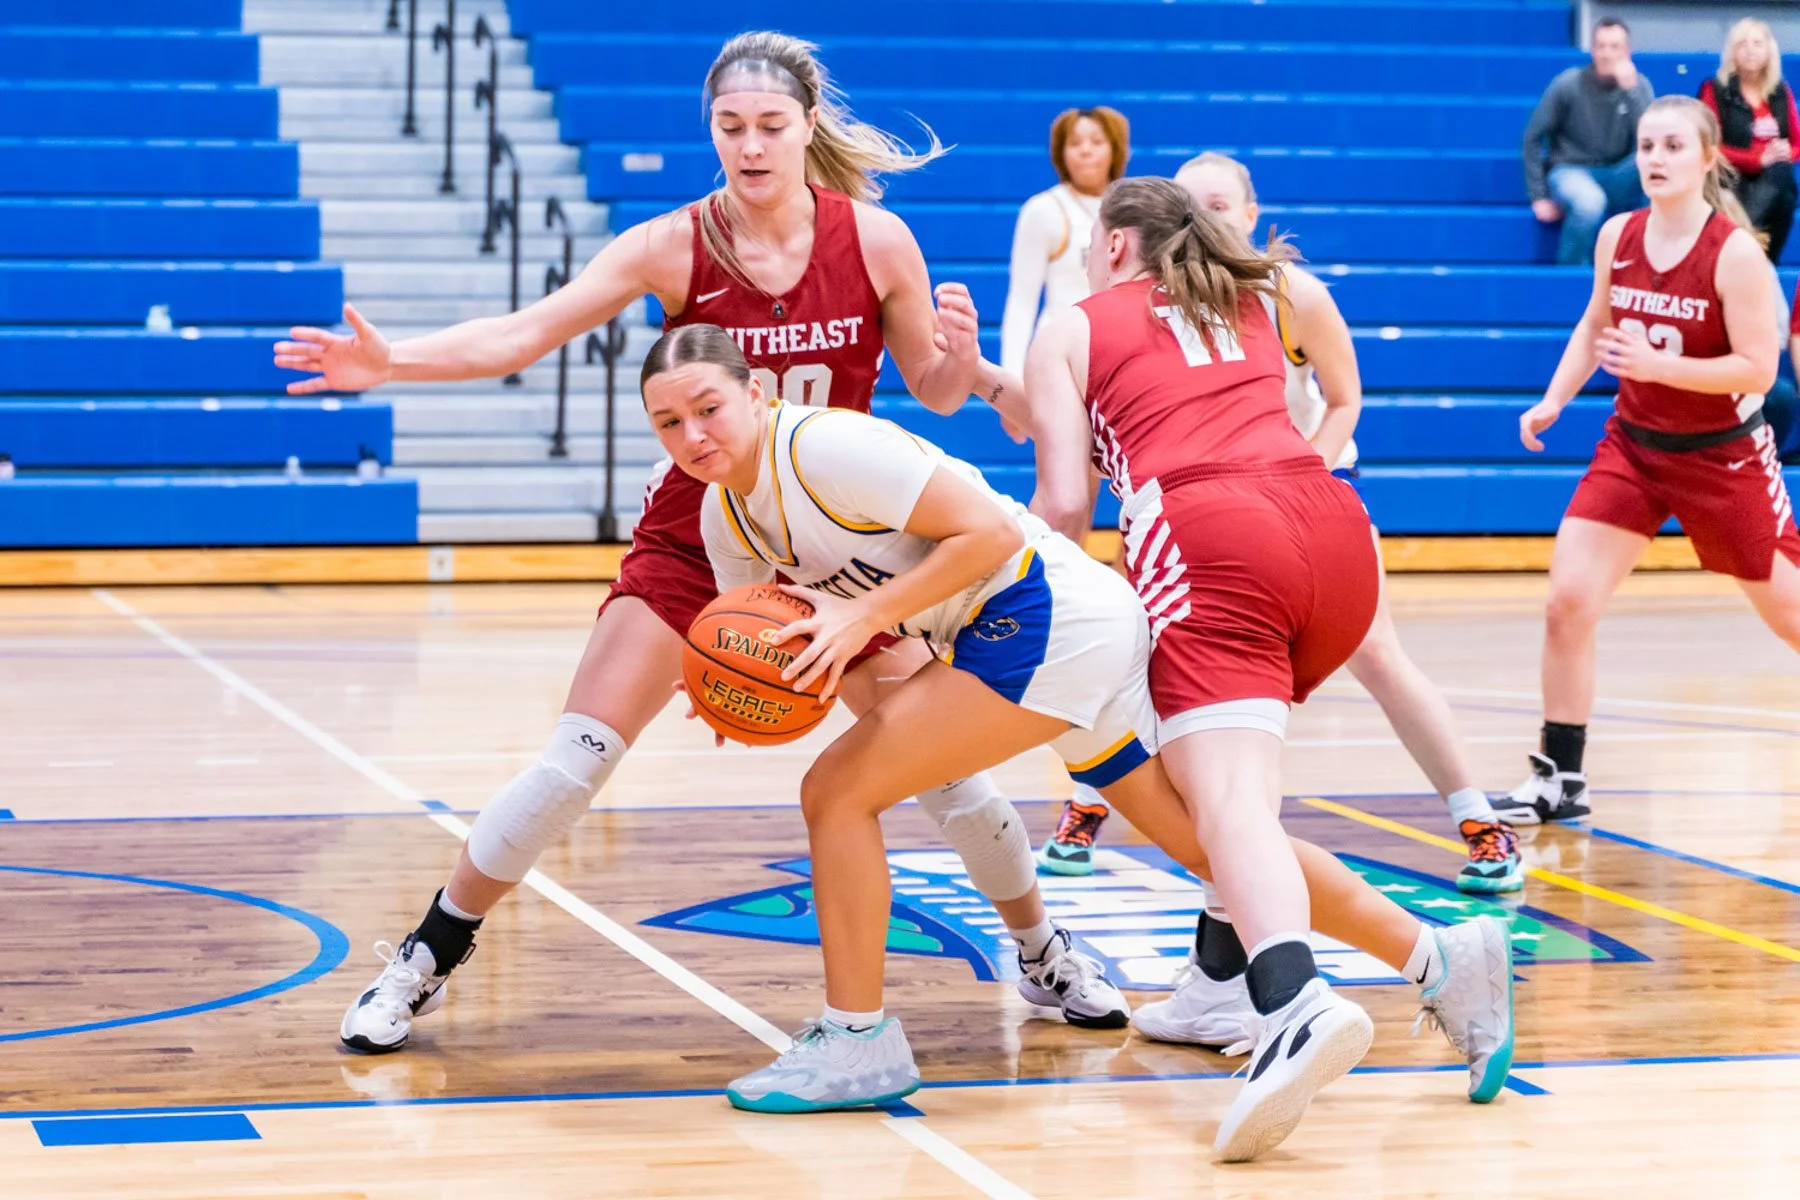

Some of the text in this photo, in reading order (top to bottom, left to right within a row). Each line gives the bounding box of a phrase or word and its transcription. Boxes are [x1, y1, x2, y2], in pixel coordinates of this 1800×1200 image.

[726, 315, 864, 355] UTHEAST
[711, 626, 795, 671] SPALDIN
[702, 670, 794, 716] LEGACY
